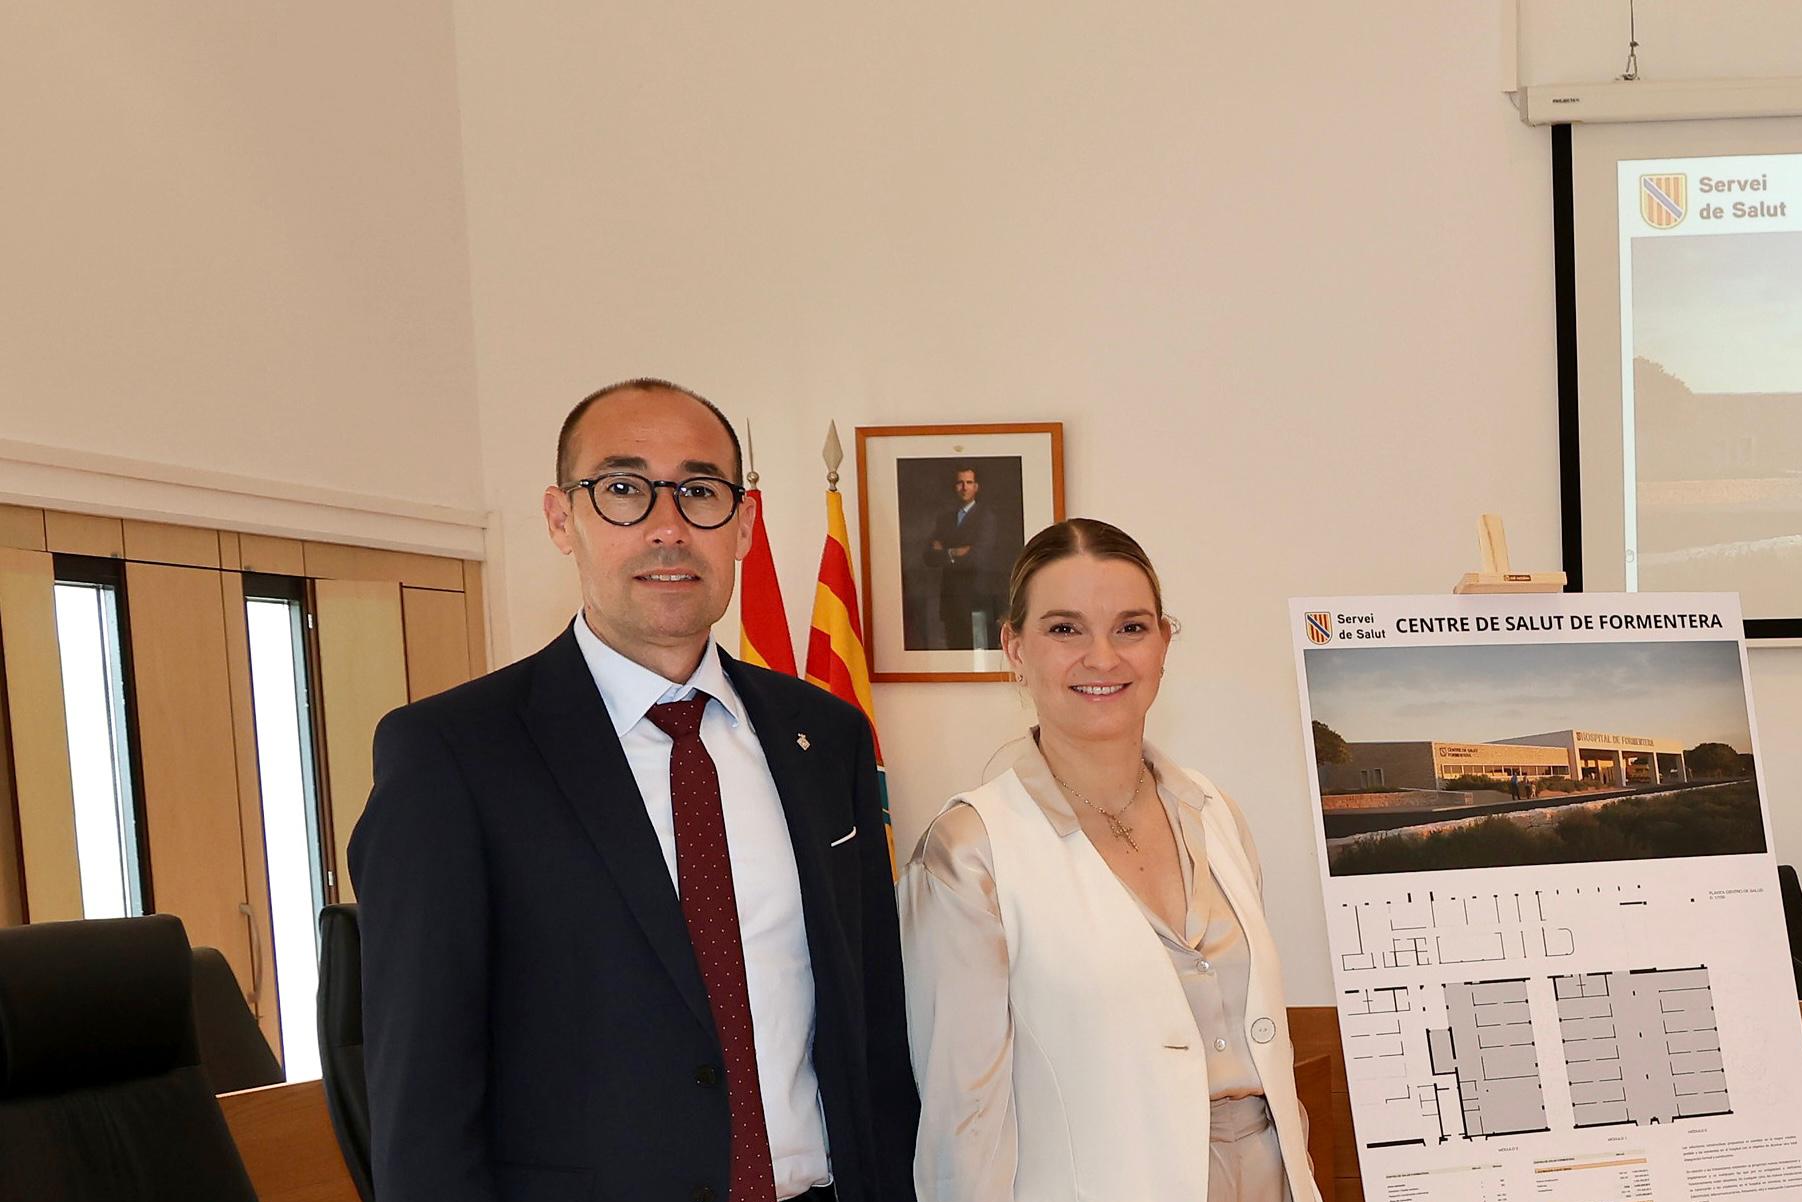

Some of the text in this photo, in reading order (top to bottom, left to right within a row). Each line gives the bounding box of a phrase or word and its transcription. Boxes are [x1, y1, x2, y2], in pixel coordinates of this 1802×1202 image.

[1698, 174, 1767, 193] Servei
[1699, 201, 1786, 220] de Salut
[1337, 613, 1374, 624] Servei
[1396, 614, 1723, 633] CENTRE DE SALUT DE FORMENTERA
[1339, 629, 1386, 639] de Salut
